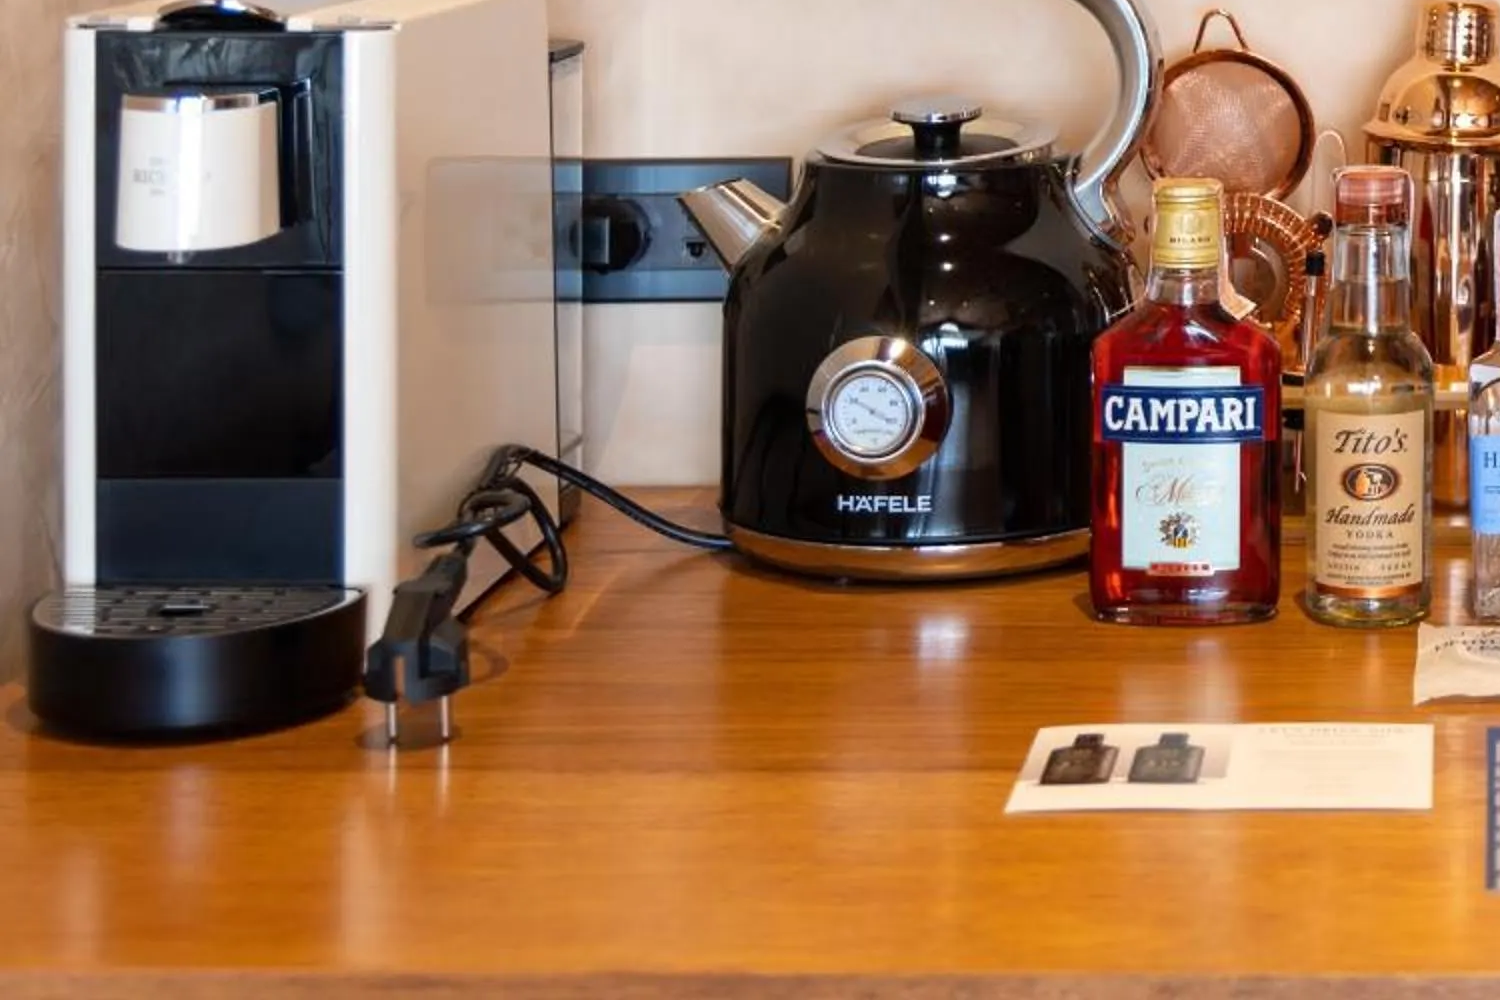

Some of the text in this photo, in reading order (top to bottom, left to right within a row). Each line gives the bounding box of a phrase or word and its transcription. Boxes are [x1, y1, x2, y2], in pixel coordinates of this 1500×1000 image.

[1105, 395, 1257, 432] CAMPARI
[1333, 427, 1409, 453] Tito's
[837, 495, 932, 513] HÄFELE
[1324, 503, 1416, 526] Handmade
